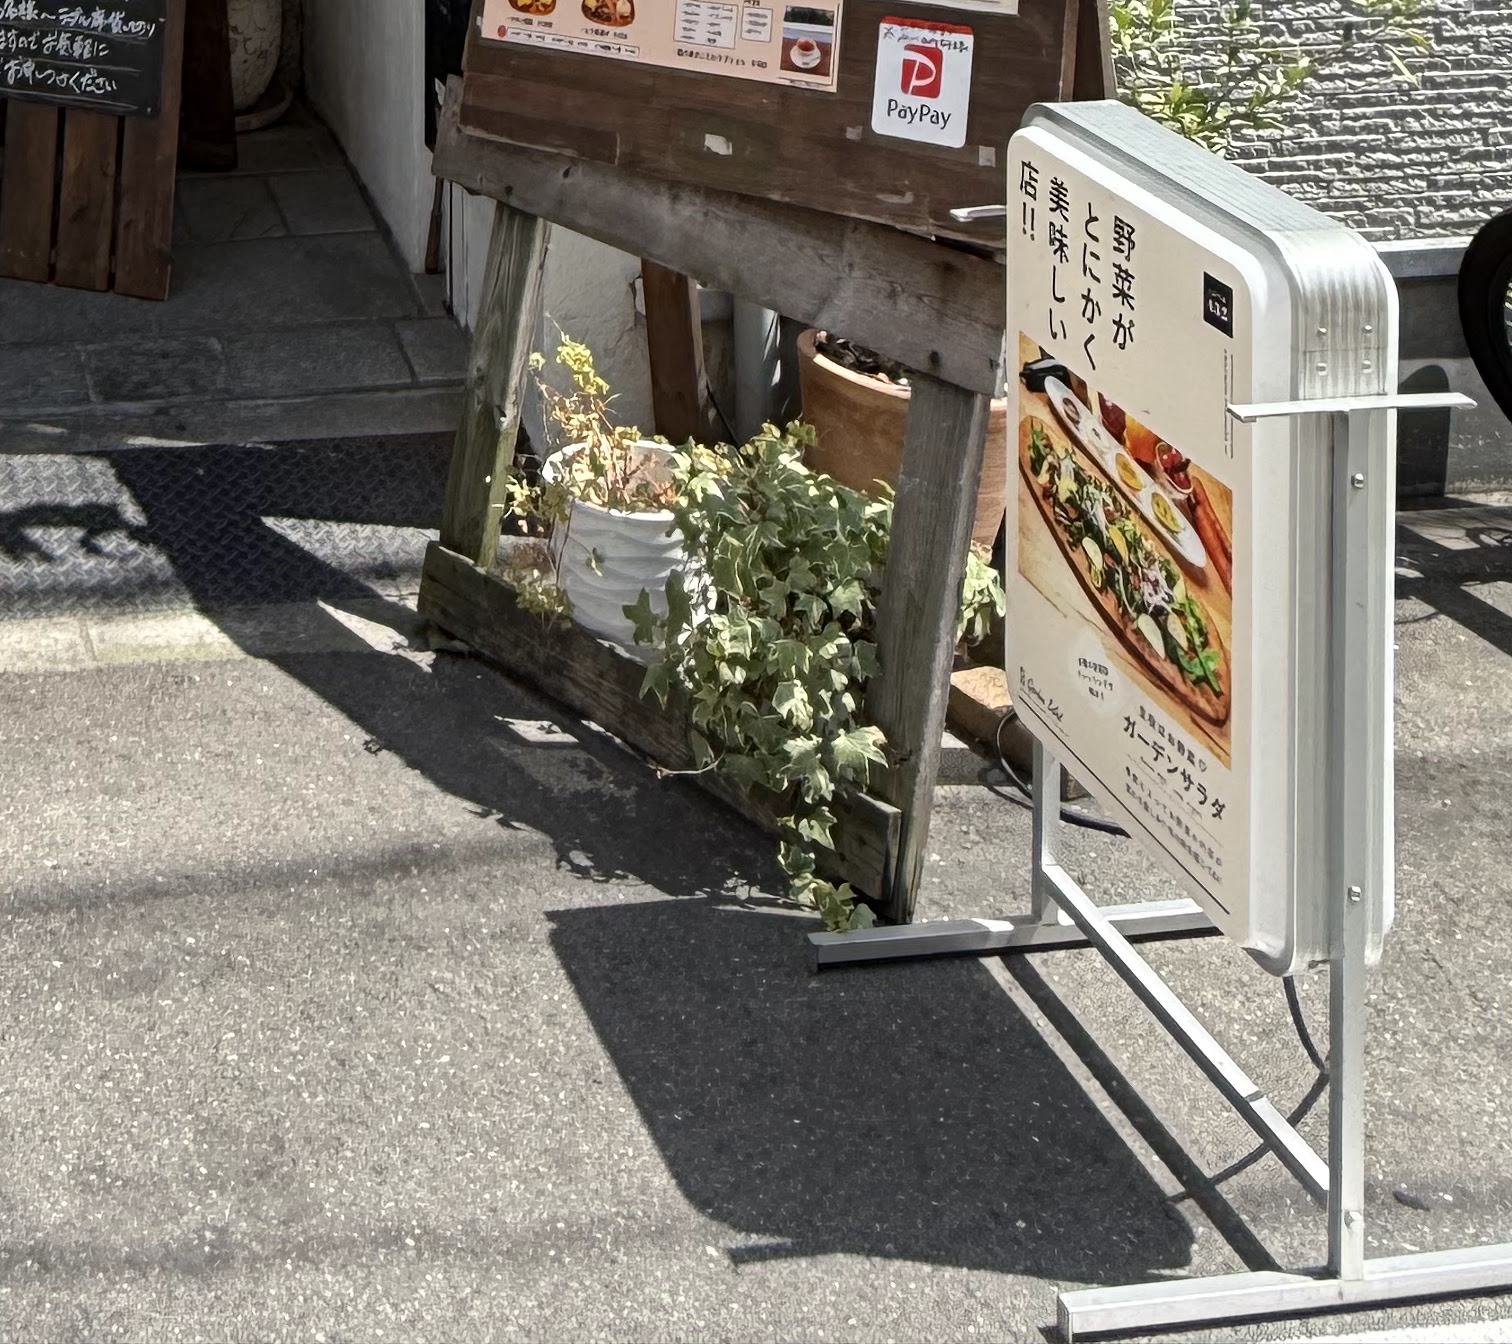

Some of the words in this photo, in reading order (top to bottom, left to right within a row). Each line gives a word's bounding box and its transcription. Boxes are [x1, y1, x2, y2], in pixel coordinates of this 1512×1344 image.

[887, 98, 952, 130] PayPay
[1048, 175, 1071, 341] 美味しい
[1080, 201, 1102, 372] とにかく
[1111, 215, 1137, 351] 野菜が
[1122, 715, 1227, 821] ガーデンサラダ
